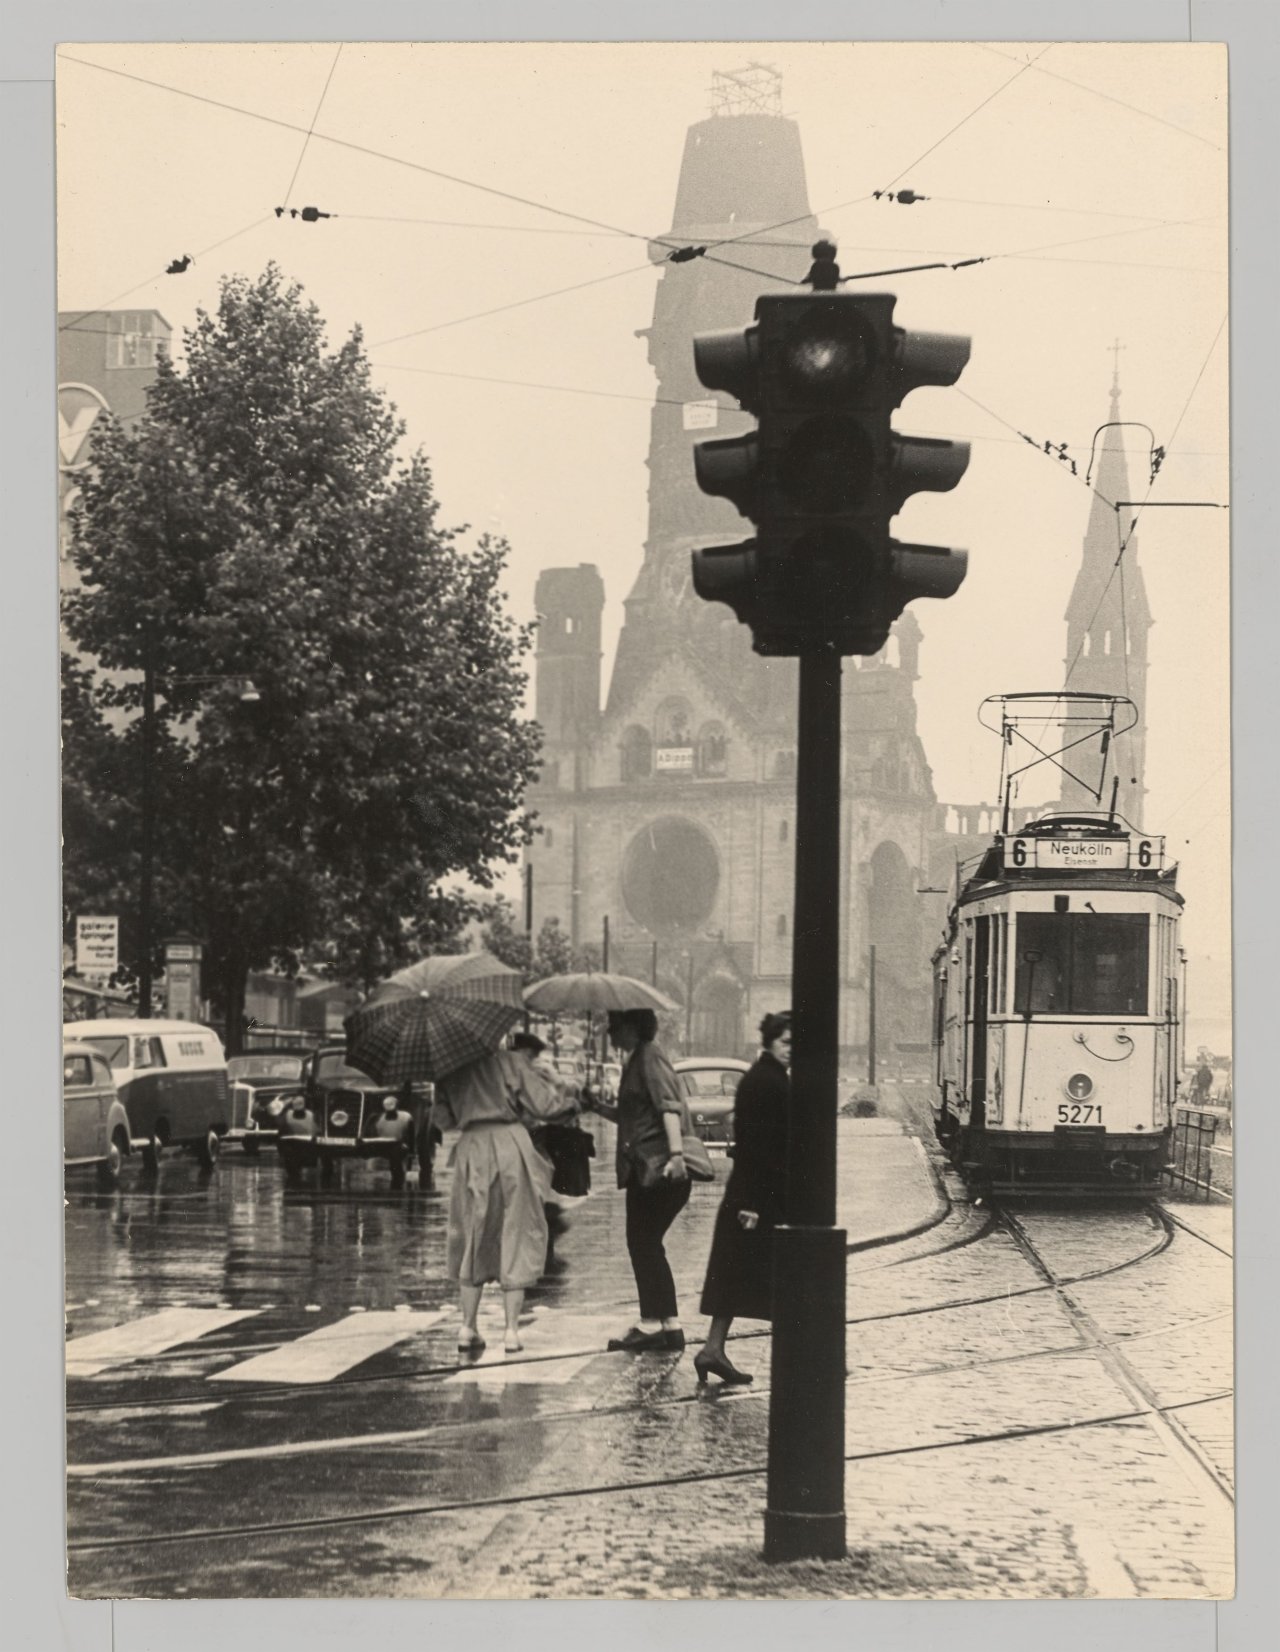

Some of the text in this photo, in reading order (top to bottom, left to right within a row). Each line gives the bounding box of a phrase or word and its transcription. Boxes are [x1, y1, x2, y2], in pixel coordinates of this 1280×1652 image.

[1012, 839, 1026, 867] 6
[1051, 841, 1112, 856] Neukölln
[1138, 840, 1152, 867] 6
[1058, 1104, 1102, 1124] 5271
